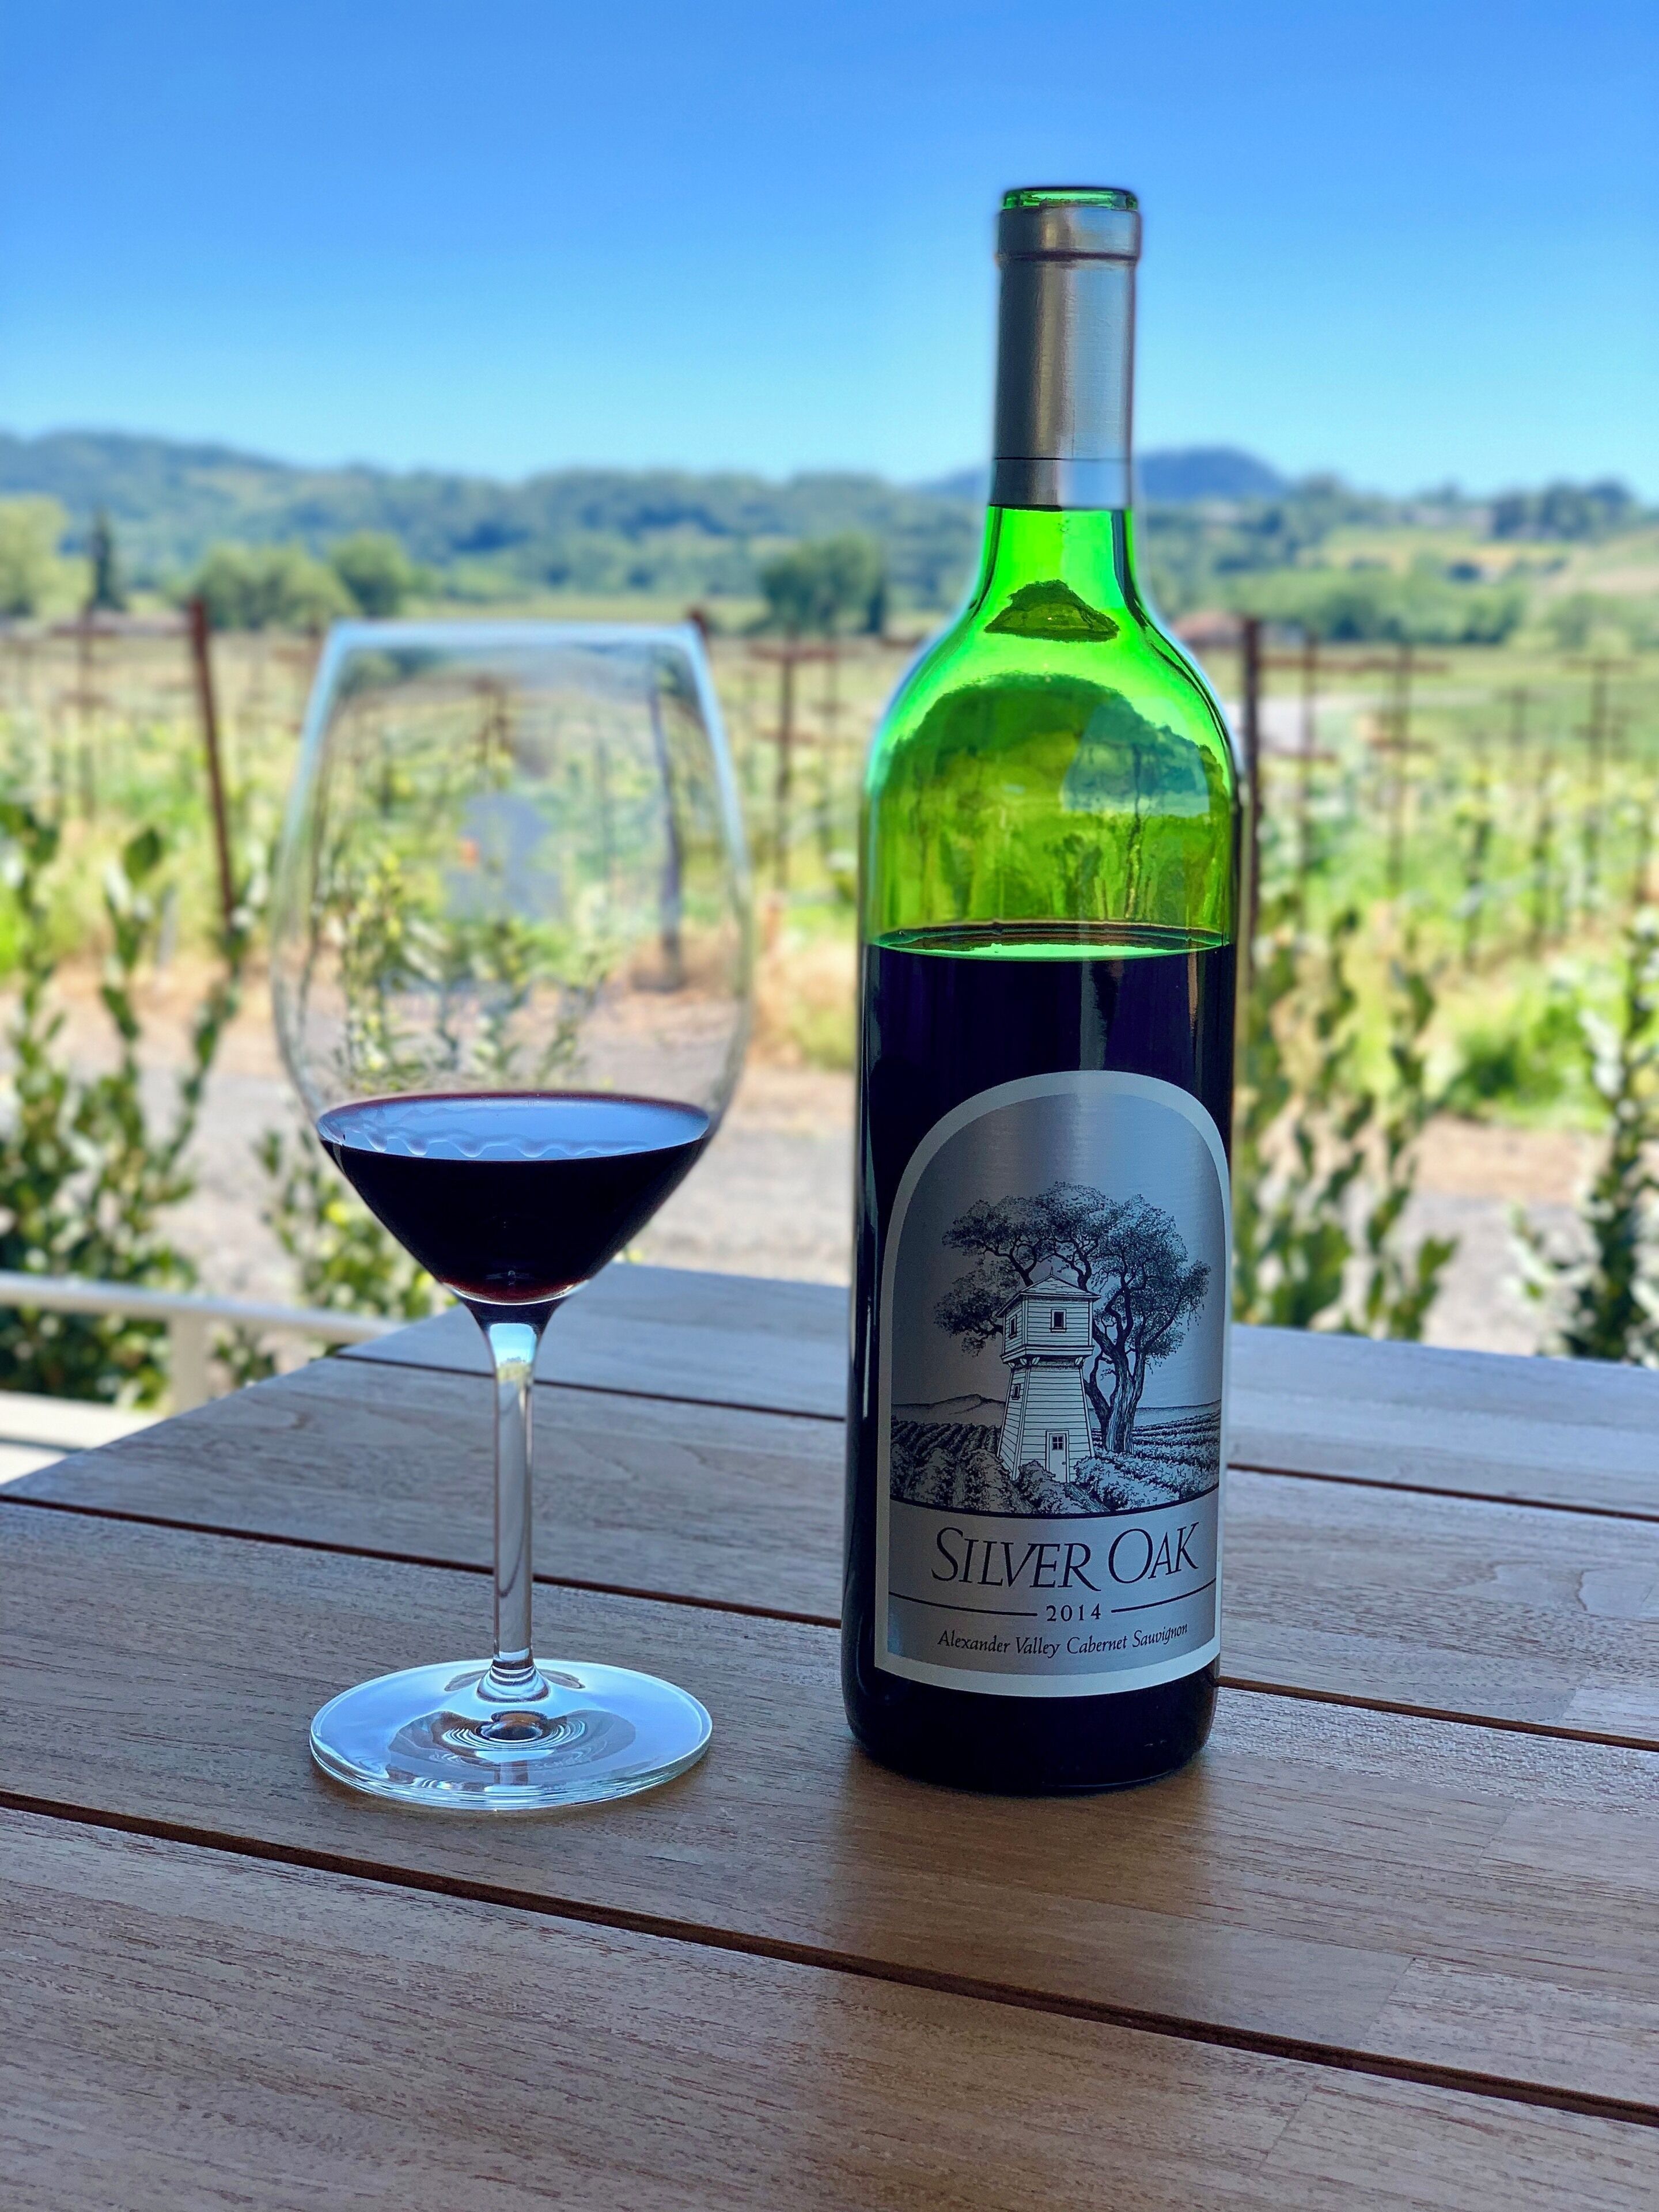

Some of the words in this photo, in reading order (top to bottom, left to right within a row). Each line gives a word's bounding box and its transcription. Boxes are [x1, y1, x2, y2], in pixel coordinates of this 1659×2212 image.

[931, 1527, 1101, 1592] SILVER
[1108, 1522, 1199, 1584] OAK
[1046, 1604, 1101, 1622] 2014
[937, 1631, 1010, 1654] Alexander
[1016, 1637, 1060, 1659] Valley
[1066, 1635, 1127, 1654] Cabernet
[1132, 1623, 1188, 1648] Sauvignon
